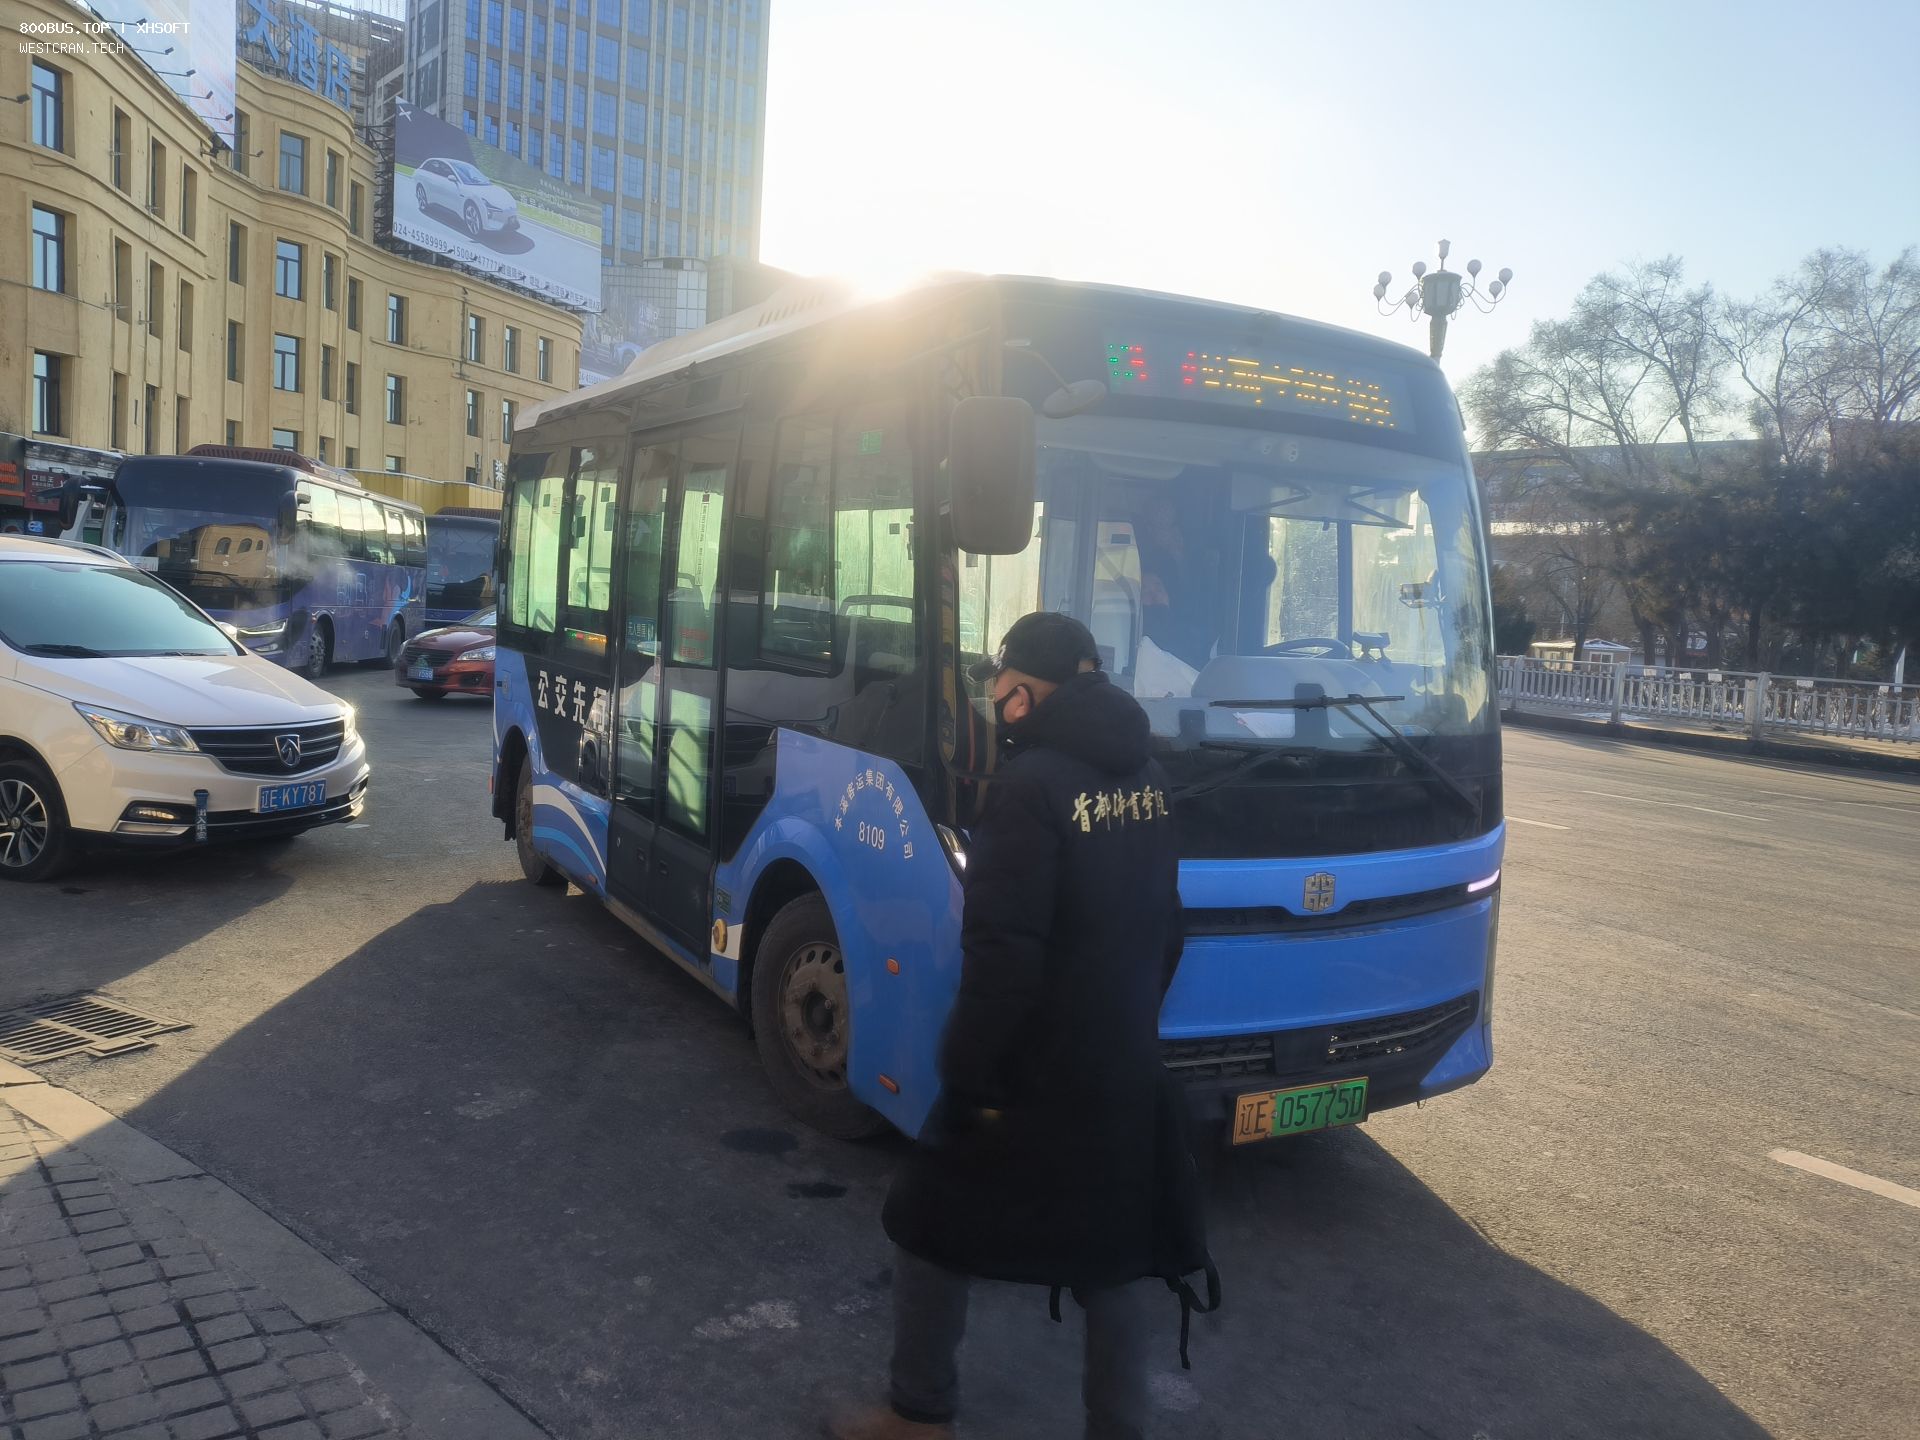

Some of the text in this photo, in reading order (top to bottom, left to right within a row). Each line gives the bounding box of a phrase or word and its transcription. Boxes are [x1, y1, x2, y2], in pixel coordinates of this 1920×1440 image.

[537, 670, 607, 733] 公交先行
[834, 768, 914, 859] 本溪客运集团有限公司
[858, 821, 885, 850] 8109
